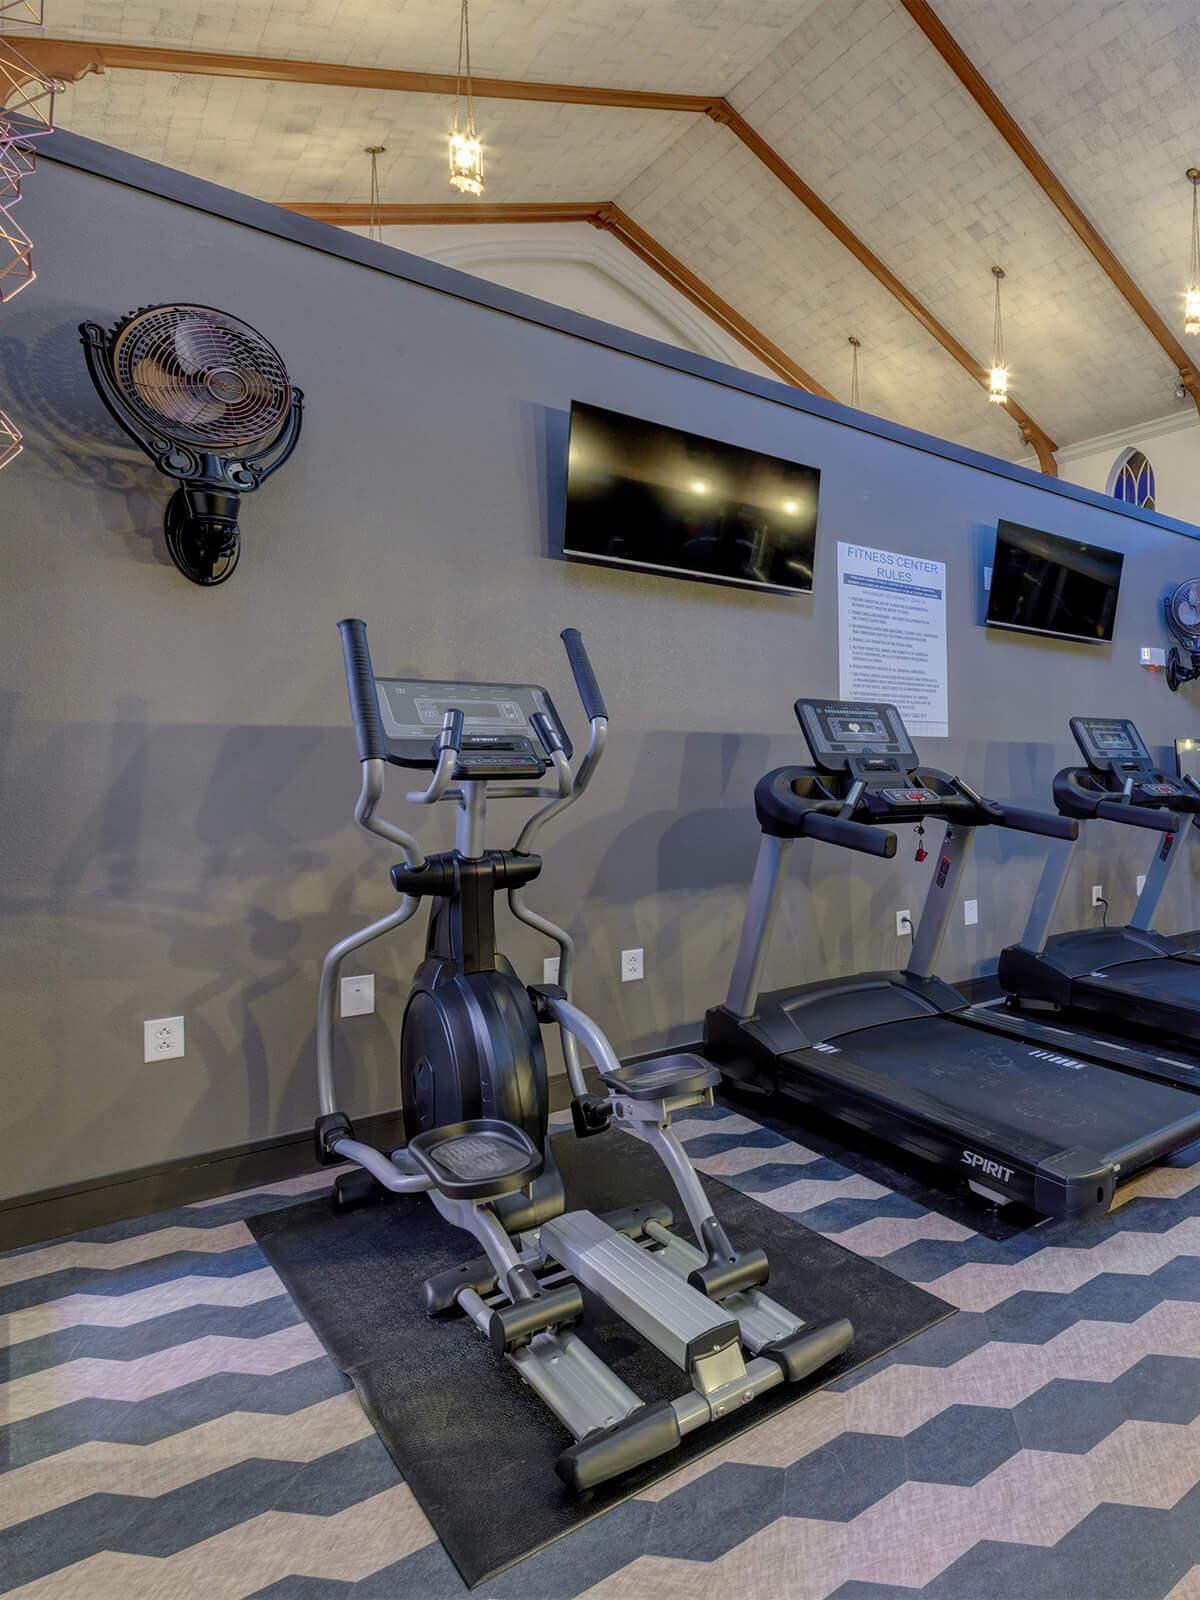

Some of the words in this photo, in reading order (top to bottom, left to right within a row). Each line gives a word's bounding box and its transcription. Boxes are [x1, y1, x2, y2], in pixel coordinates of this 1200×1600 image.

[847, 546, 894, 566] FITNESS
[896, 557, 938, 574] CENTER
[877, 567, 913, 583] RULES
[960, 1150, 1015, 1182] SPIRIT
